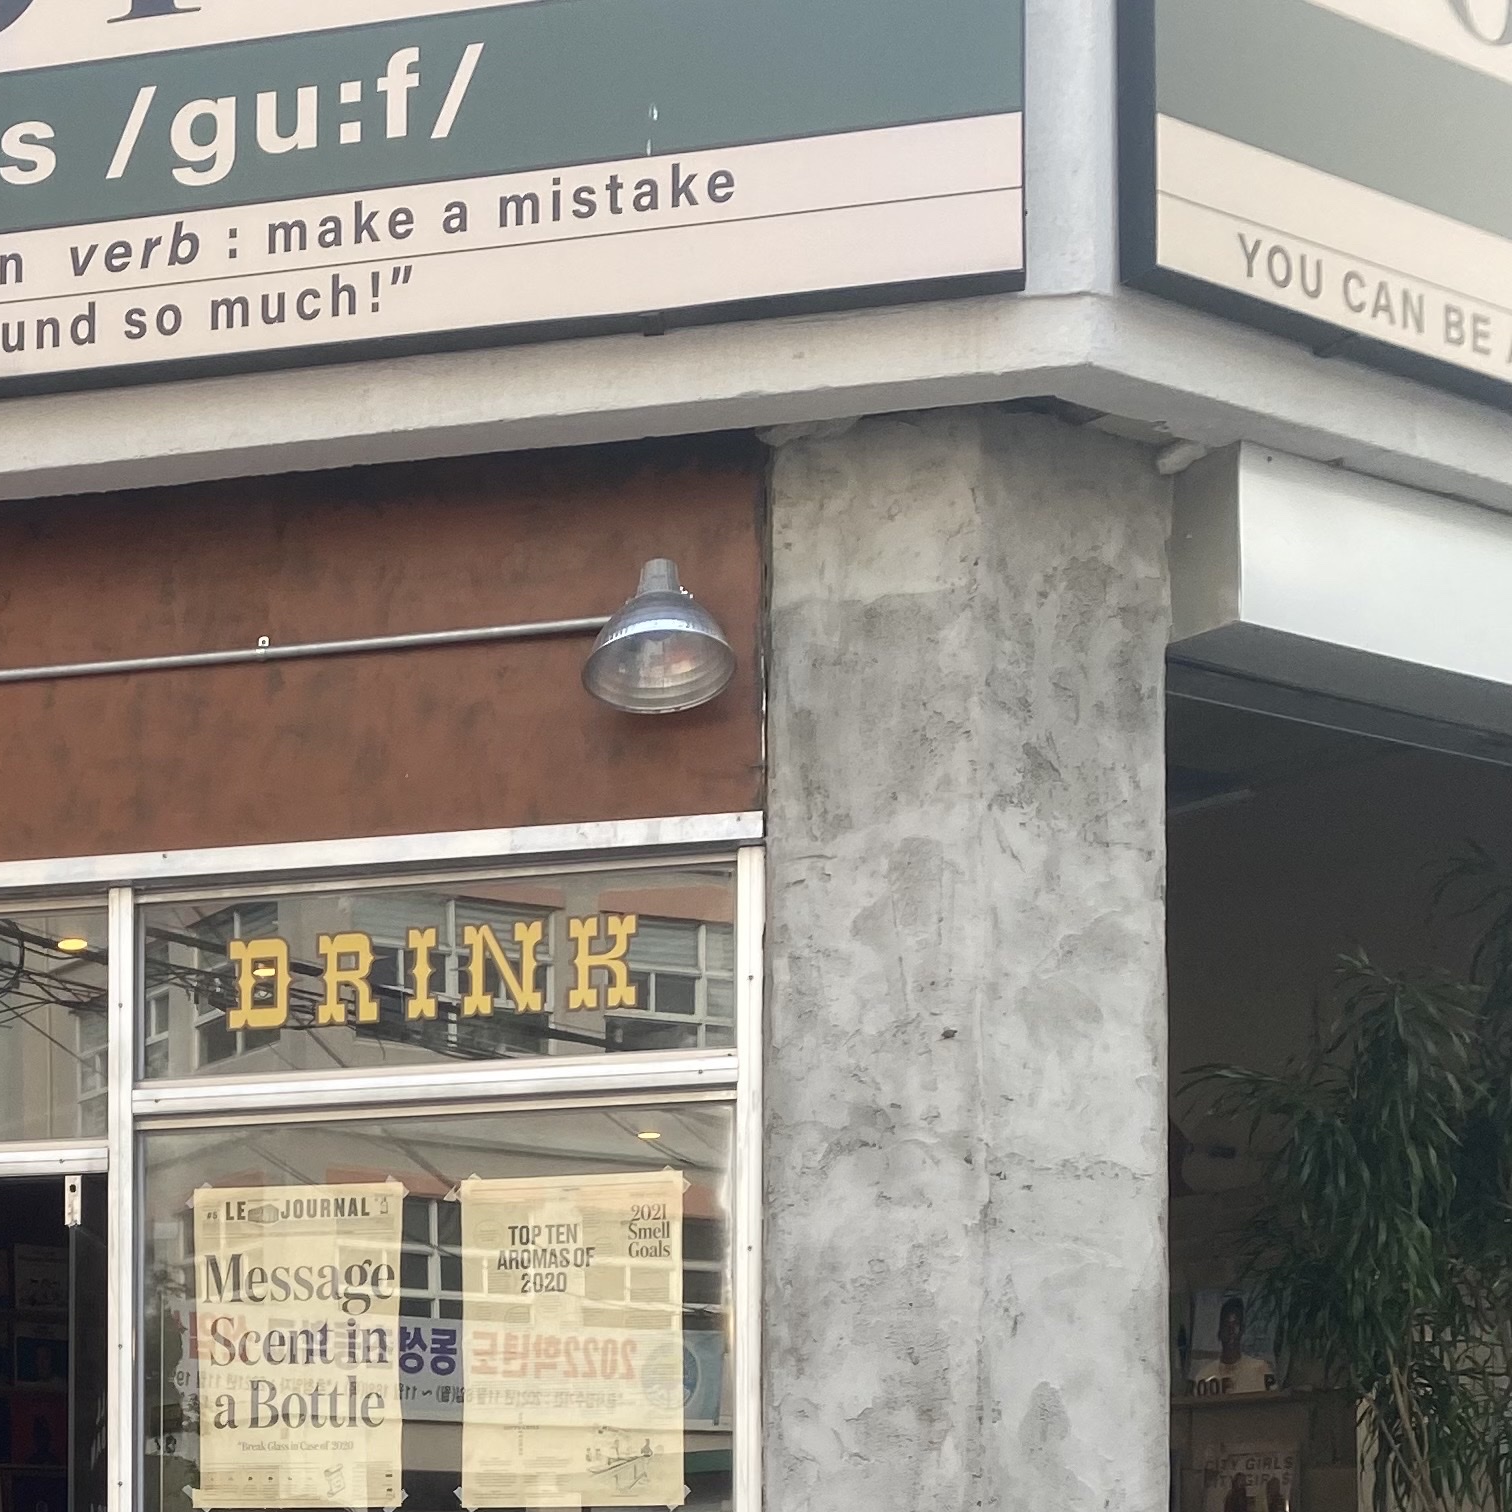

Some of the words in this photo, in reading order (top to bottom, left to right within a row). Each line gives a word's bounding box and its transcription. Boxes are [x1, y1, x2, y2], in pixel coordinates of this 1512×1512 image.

[106, 42, 486, 187] /gu:f/
[68, 220, 204, 278] verb
[264, 197, 416, 257] make
[440, 197, 470, 235] a
[496, 162, 738, 229] mistake
[1237, 231, 1324, 299] YOU
[1341, 270, 1426, 335] CAN
[1443, 304, 1492, 356] BE
[121, 303, 184, 343] so
[225, 913, 639, 1033] DRINK
[225, 1201, 247, 1221] LE
[280, 1196, 371, 1220] JOURNAL
[627, 1220, 671, 1241] Smell
[507, 1225, 542, 1246] TOP
[545, 1223, 578, 1245] TEN
[627, 1240, 671, 1258] Goals
[497, 1247, 570, 1271] AROMAS
[573, 1246, 596, 1268] OF
[202, 1253, 396, 1316] Message
[520, 1271, 567, 1294] 2020
[210, 1316, 335, 1367] Scent
[346, 1317, 389, 1365] in
[213, 1393, 239, 1430] a
[248, 1375, 386, 1430] Bottle
